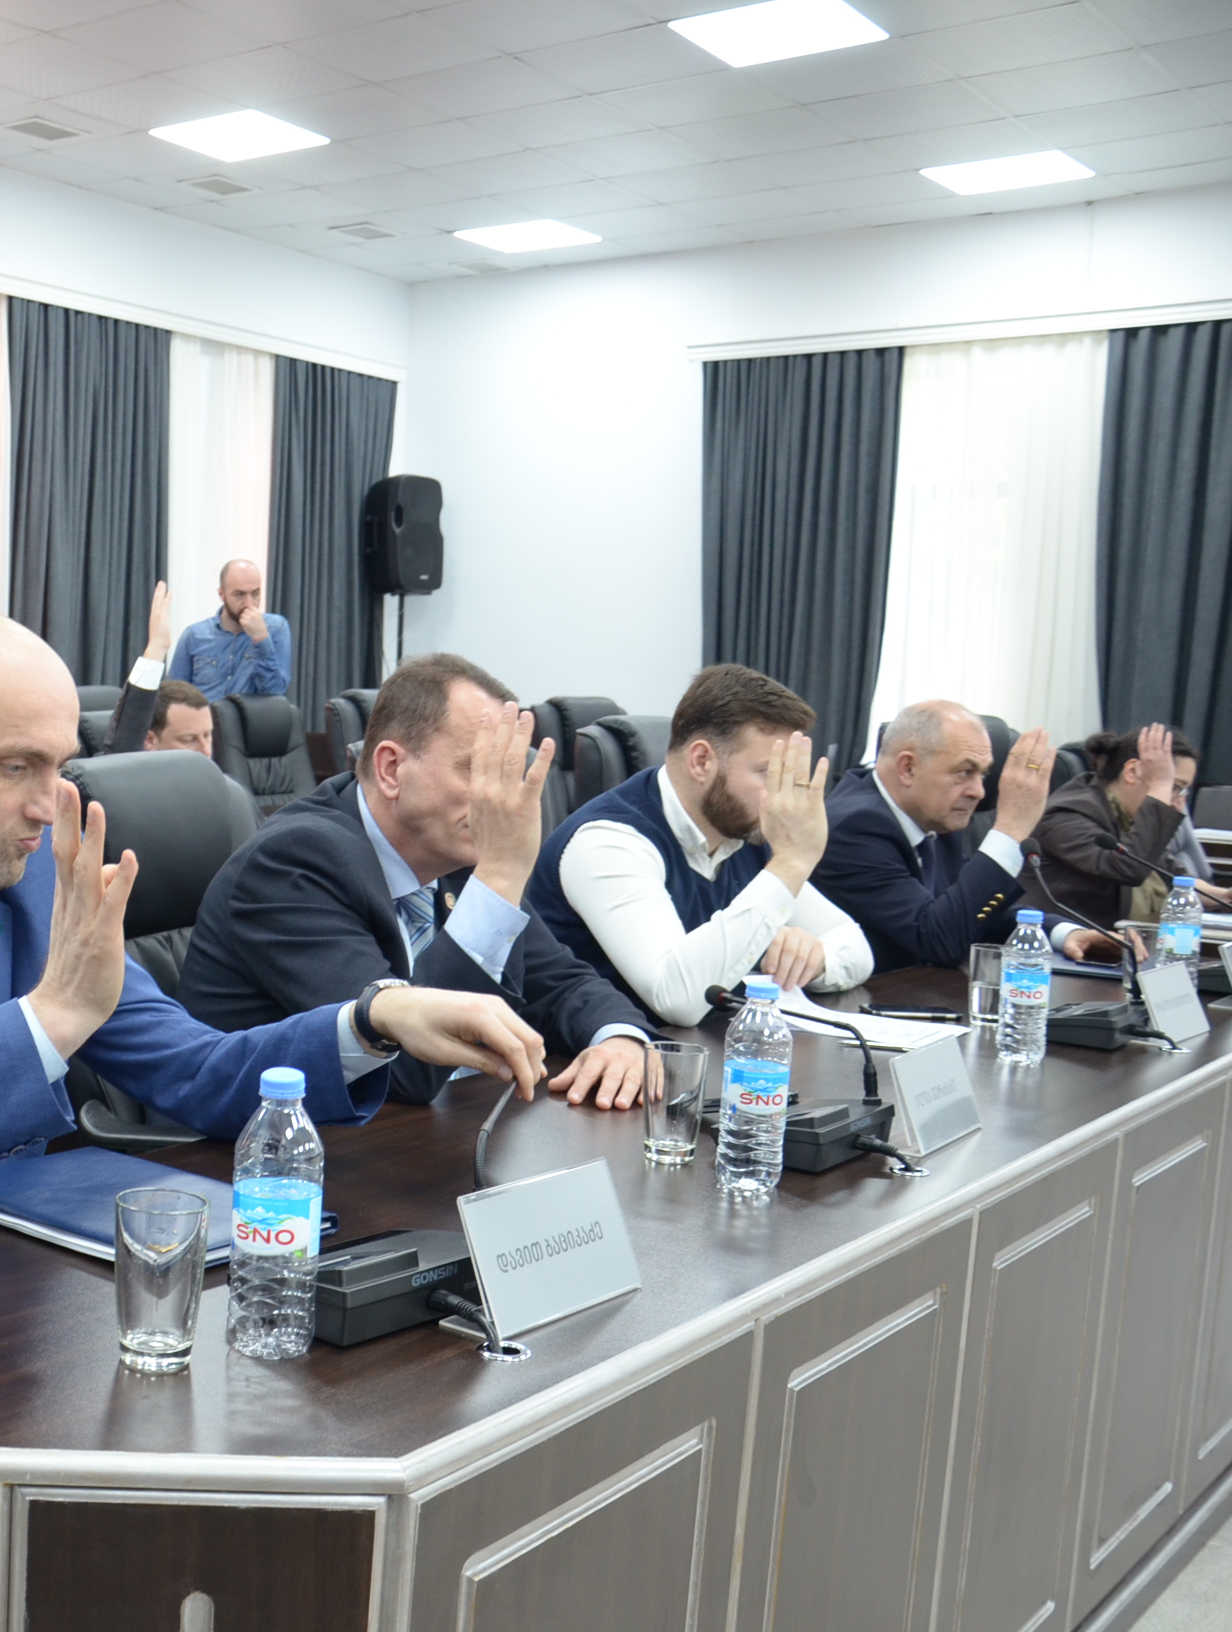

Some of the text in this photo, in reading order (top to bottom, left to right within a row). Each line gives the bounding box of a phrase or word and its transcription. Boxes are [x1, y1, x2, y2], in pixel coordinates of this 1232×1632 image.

[1009, 988, 1043, 1000] SNO
[739, 1092, 784, 1107] SNO
[236, 1223, 296, 1246] SNO
[495, 1220, 604, 1273] დავით ბაციკაძე
[411, 1262, 459, 1287] GONSIN
